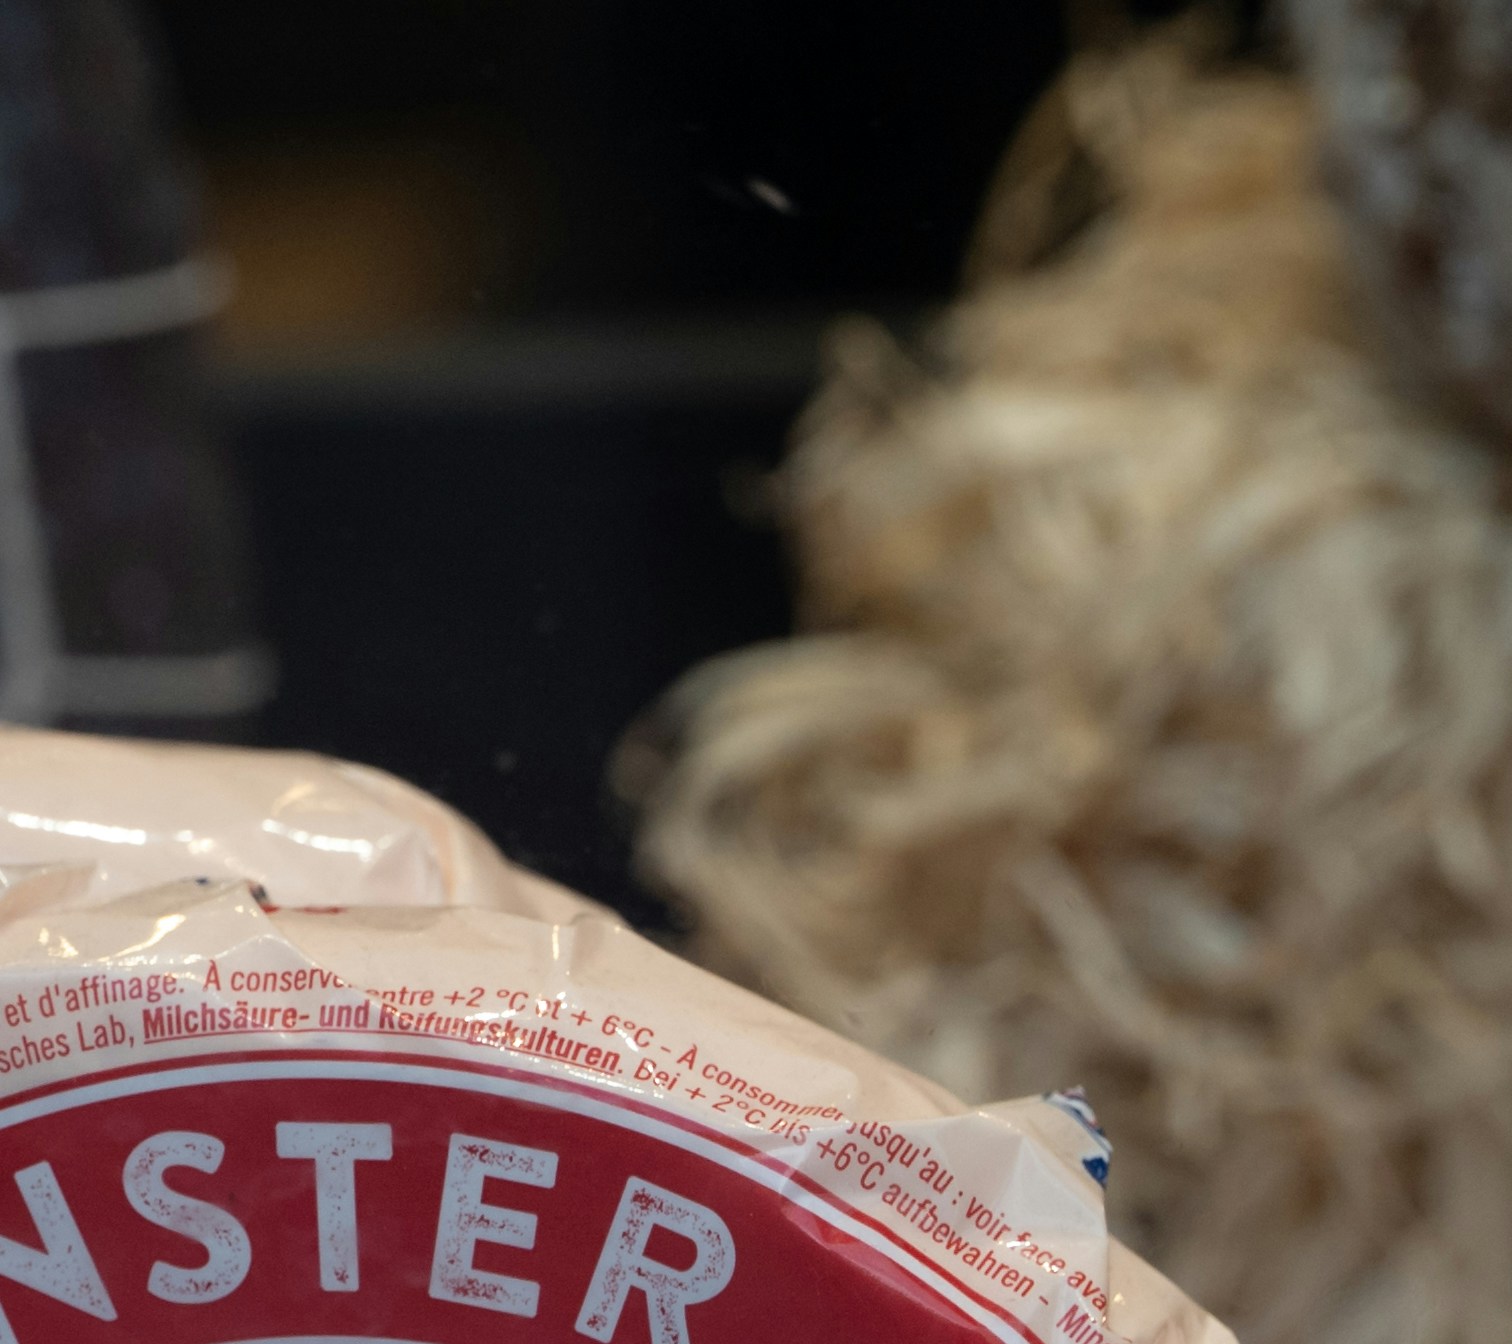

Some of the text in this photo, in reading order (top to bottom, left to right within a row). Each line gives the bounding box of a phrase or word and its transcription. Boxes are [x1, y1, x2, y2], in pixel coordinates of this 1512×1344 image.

[5, 994, 31, 1027] et
[39, 973, 185, 1018] d'affinage.
[203, 959, 222, 990] À
[676, 1043, 700, 1071] À
[966, 1197, 1011, 1242] voir
[76, 1016, 135, 1055] Lab,
[142, 999, 310, 1040] Milchsäure-
[320, 1000, 370, 1029] und
[881, 1182, 1035, 1298] aufbewahren
